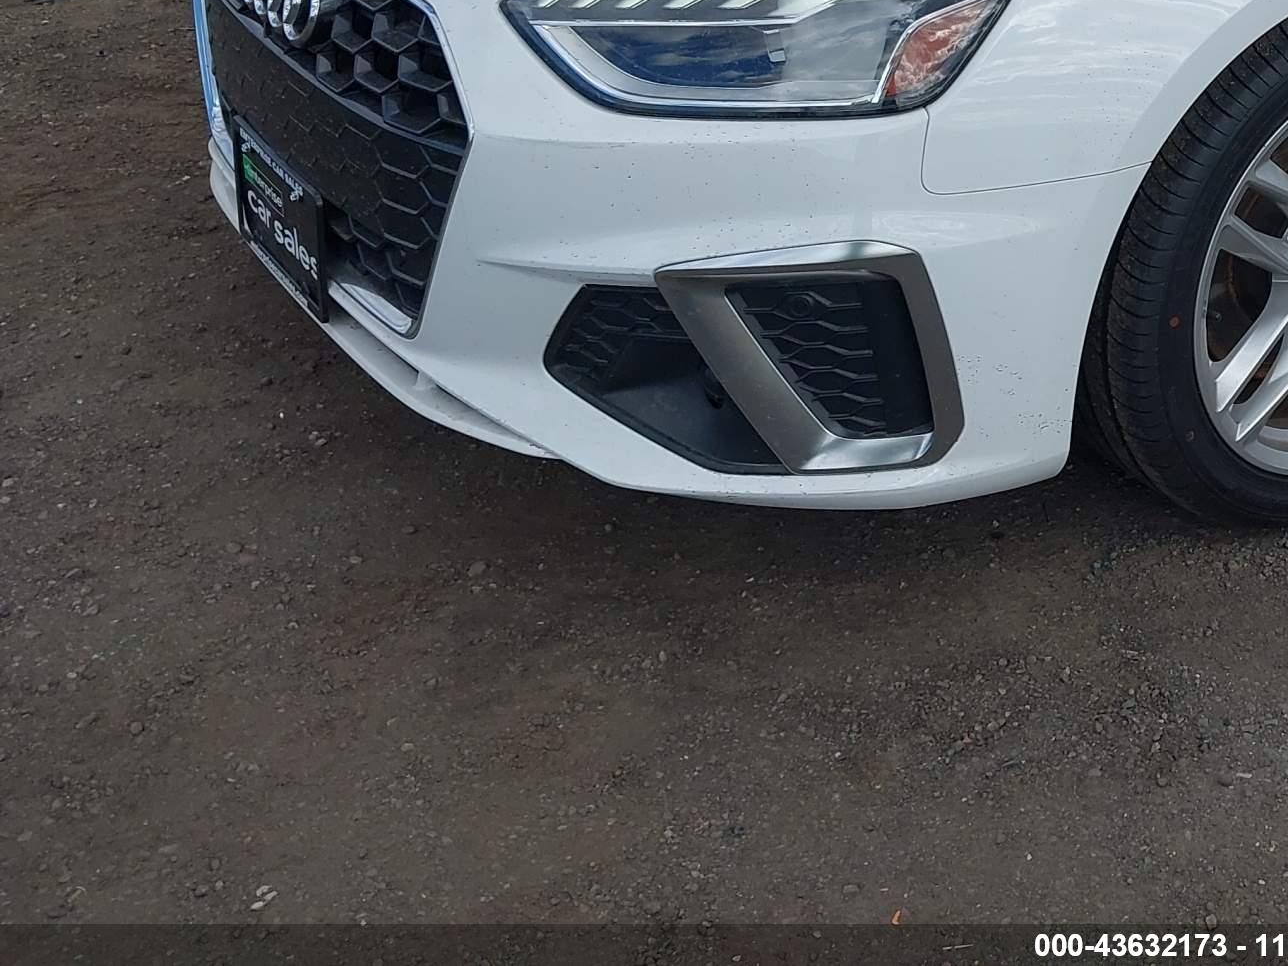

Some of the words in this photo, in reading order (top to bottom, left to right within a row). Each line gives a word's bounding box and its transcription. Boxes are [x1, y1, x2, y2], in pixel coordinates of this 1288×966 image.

[271, 161, 285, 181] CAR
[284, 173, 304, 196] SALES
[247, 190, 272, 229] car
[273, 219, 318, 281] sales
